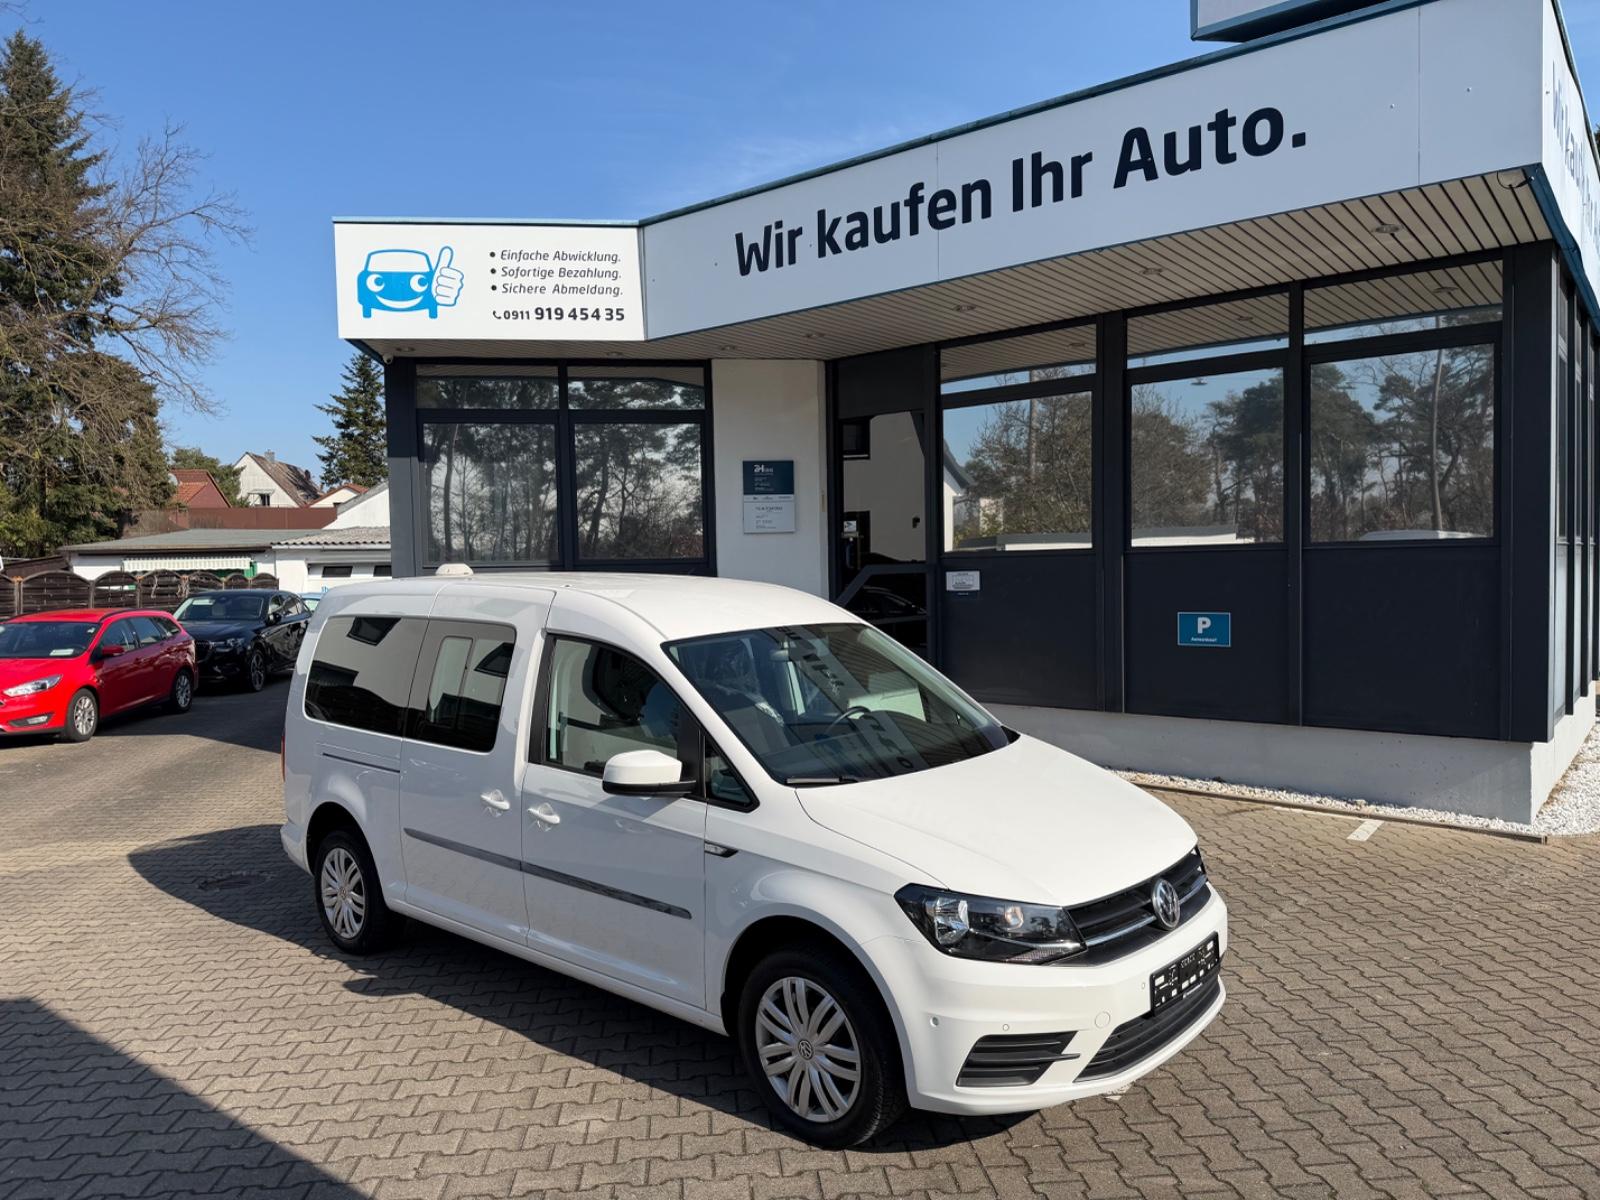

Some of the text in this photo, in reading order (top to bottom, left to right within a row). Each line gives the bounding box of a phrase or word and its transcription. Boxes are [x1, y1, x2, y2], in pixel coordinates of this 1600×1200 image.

[735, 106, 1307, 276] Wir kaufen Ihr Auto.
[500, 249, 621, 264] Einfache Abwicklung.
[501, 266, 622, 281] Sofortige Bezahlung.
[501, 283, 623, 297] Sichere Abmeldung.
[503, 310, 530, 320] 0911
[1197, 616, 1212, 634] P
